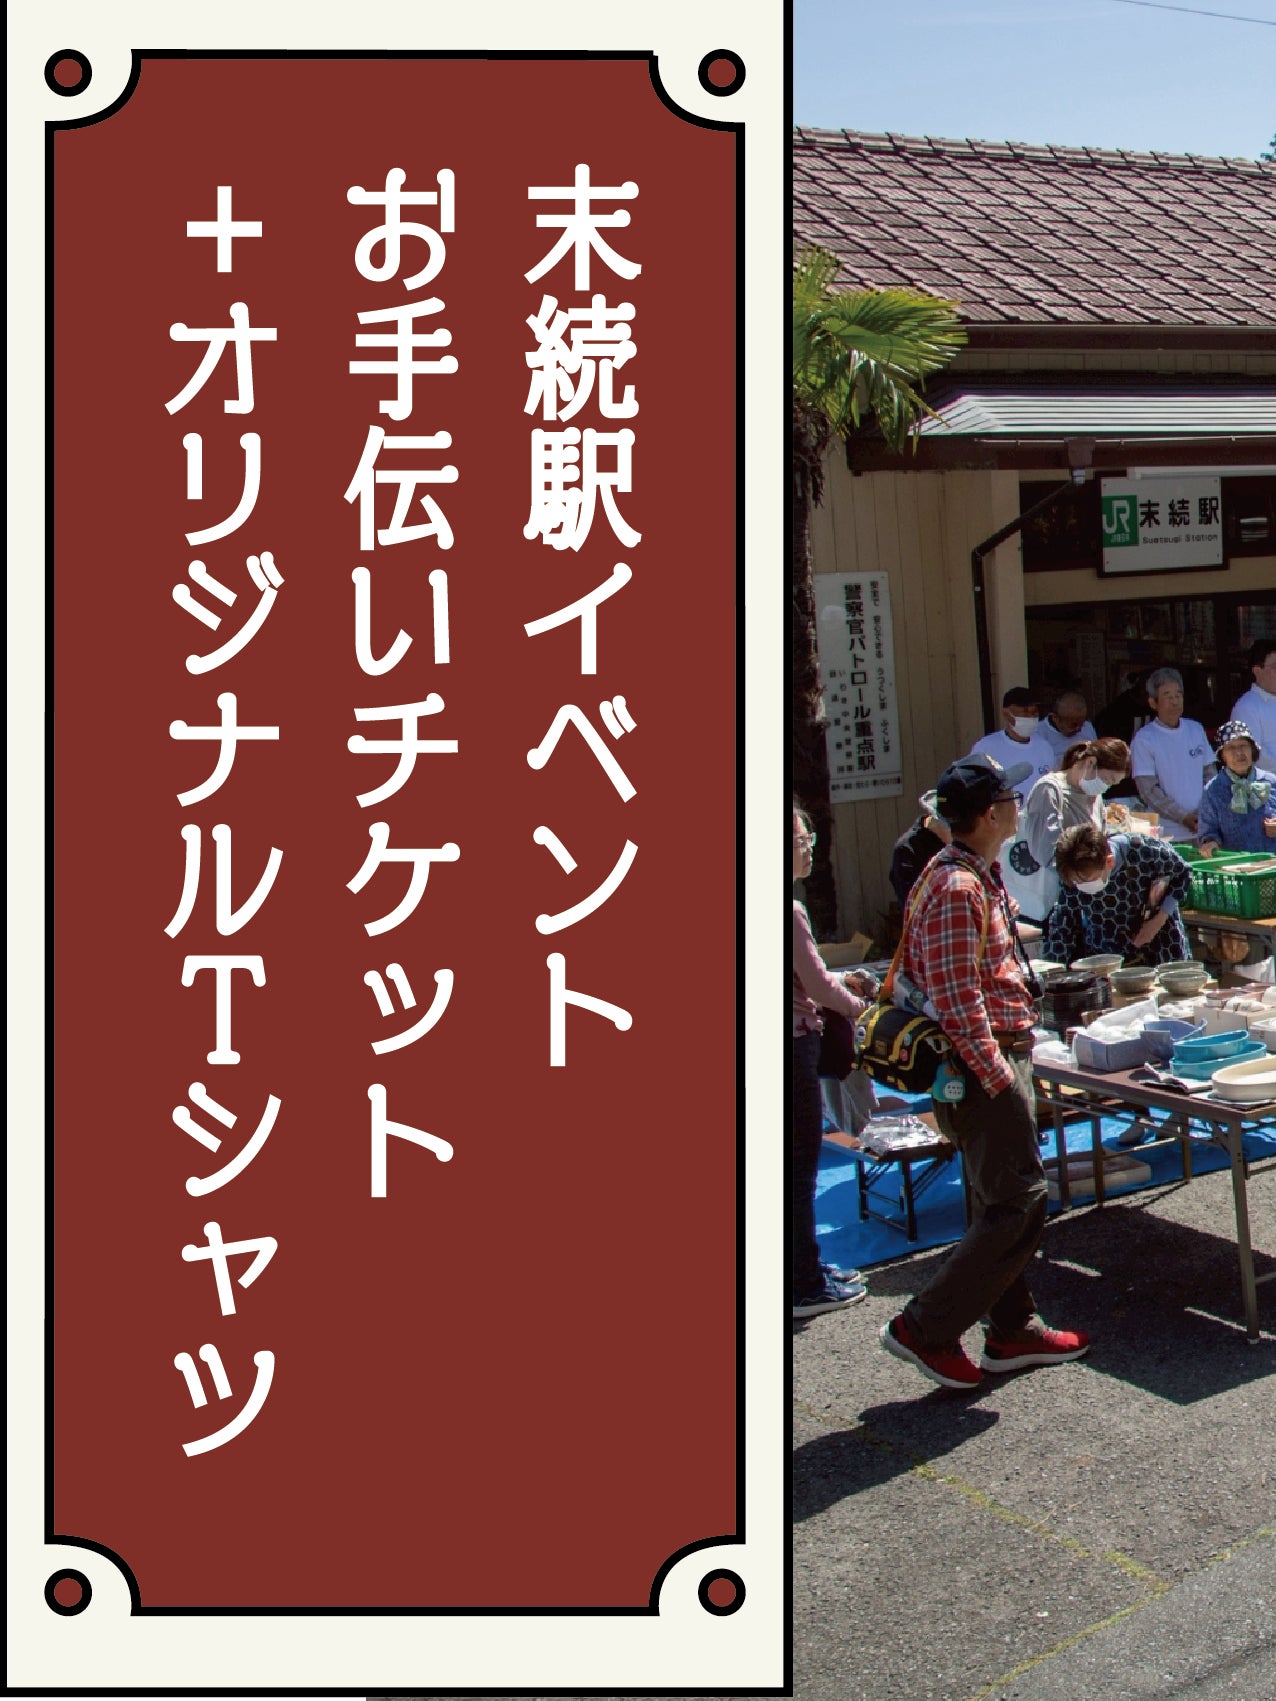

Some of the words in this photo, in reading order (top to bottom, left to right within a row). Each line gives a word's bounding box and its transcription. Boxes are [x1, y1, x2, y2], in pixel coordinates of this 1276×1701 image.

[1102, 499, 1131, 534] JR
[1139, 496, 1220, 528] 末続駅
[1184, 533, 1218, 543] Station
[844, 583, 876, 771] 警察官パトロール重点駅
